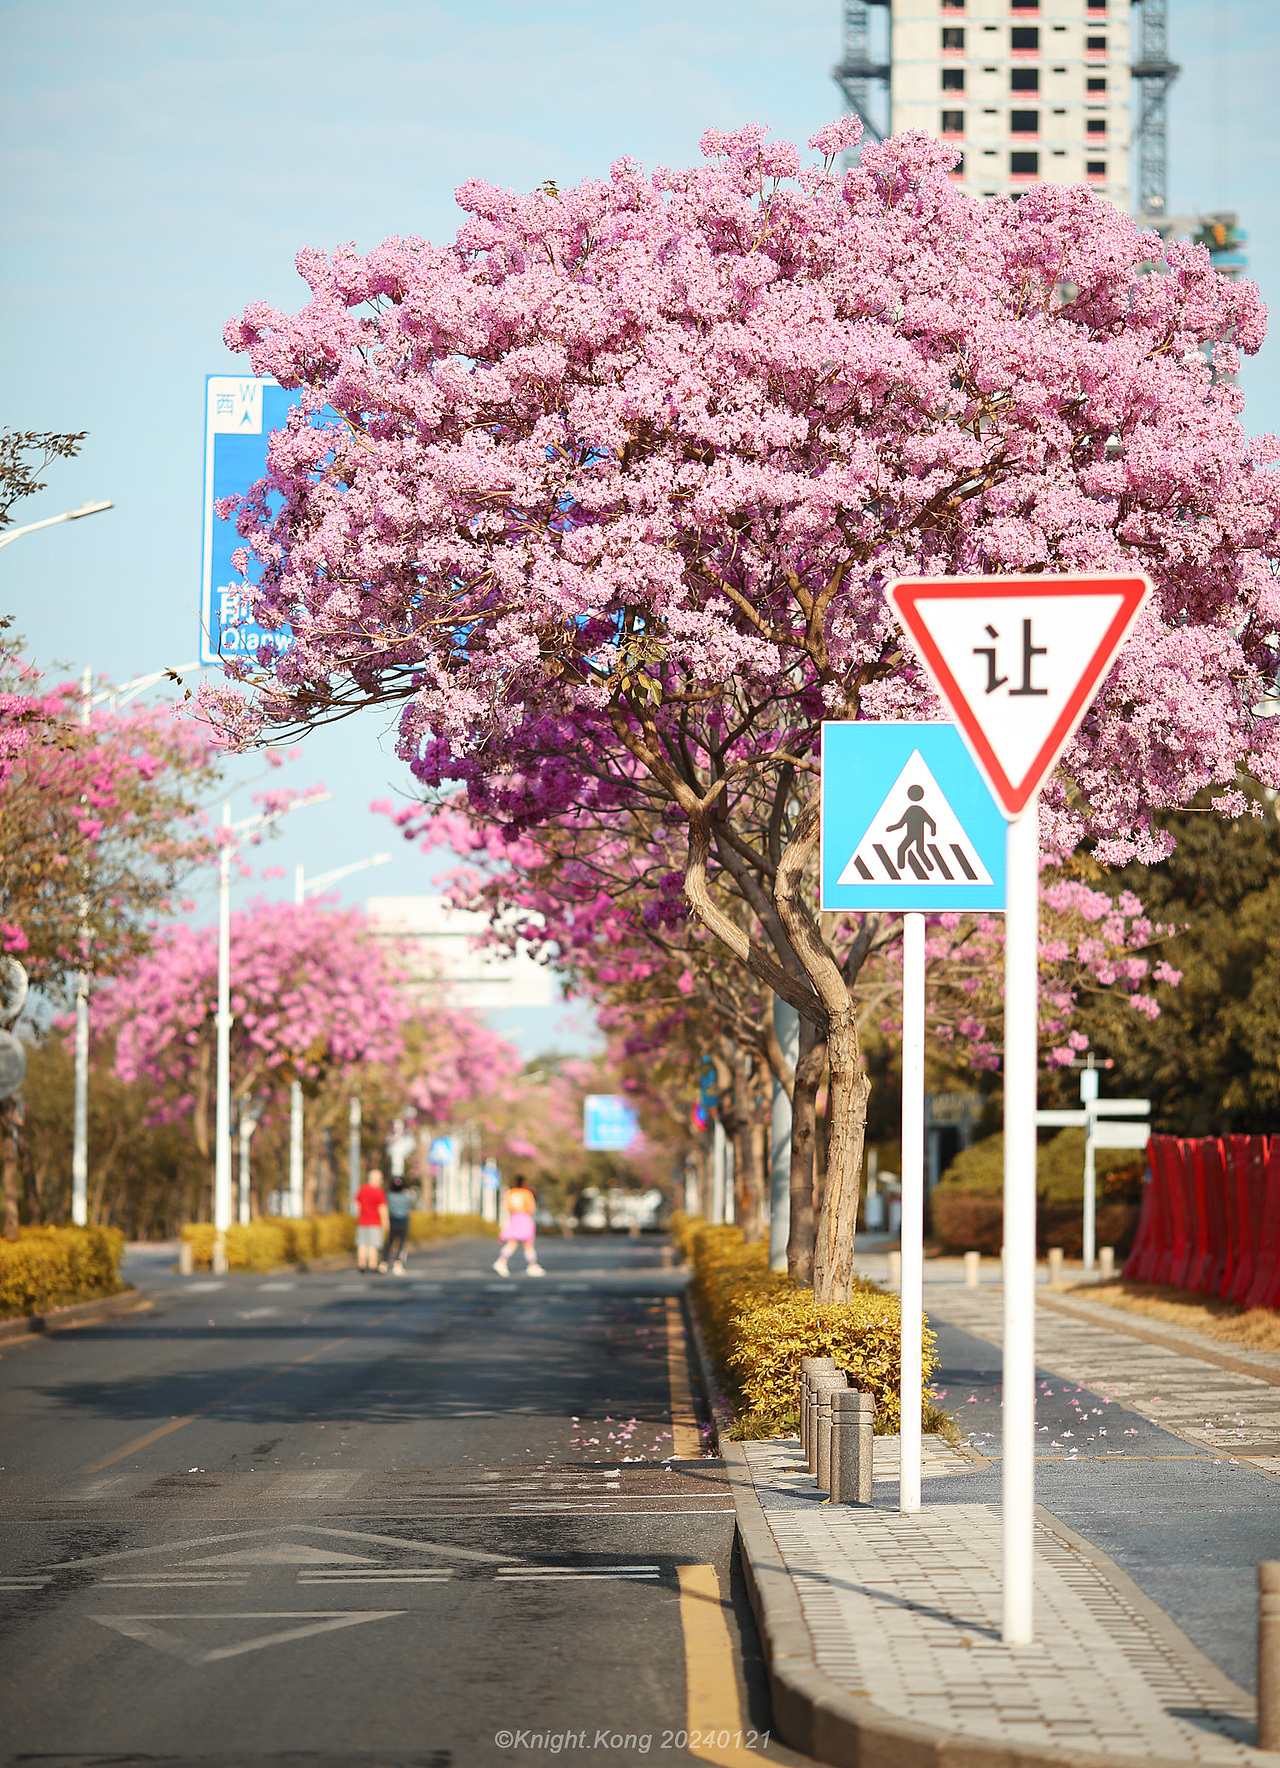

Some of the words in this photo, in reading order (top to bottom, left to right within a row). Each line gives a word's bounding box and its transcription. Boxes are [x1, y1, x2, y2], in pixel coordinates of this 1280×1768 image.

[239, 384, 257, 402] W
[216, 394, 235, 415] 西
[973, 619, 1048, 696] 让
